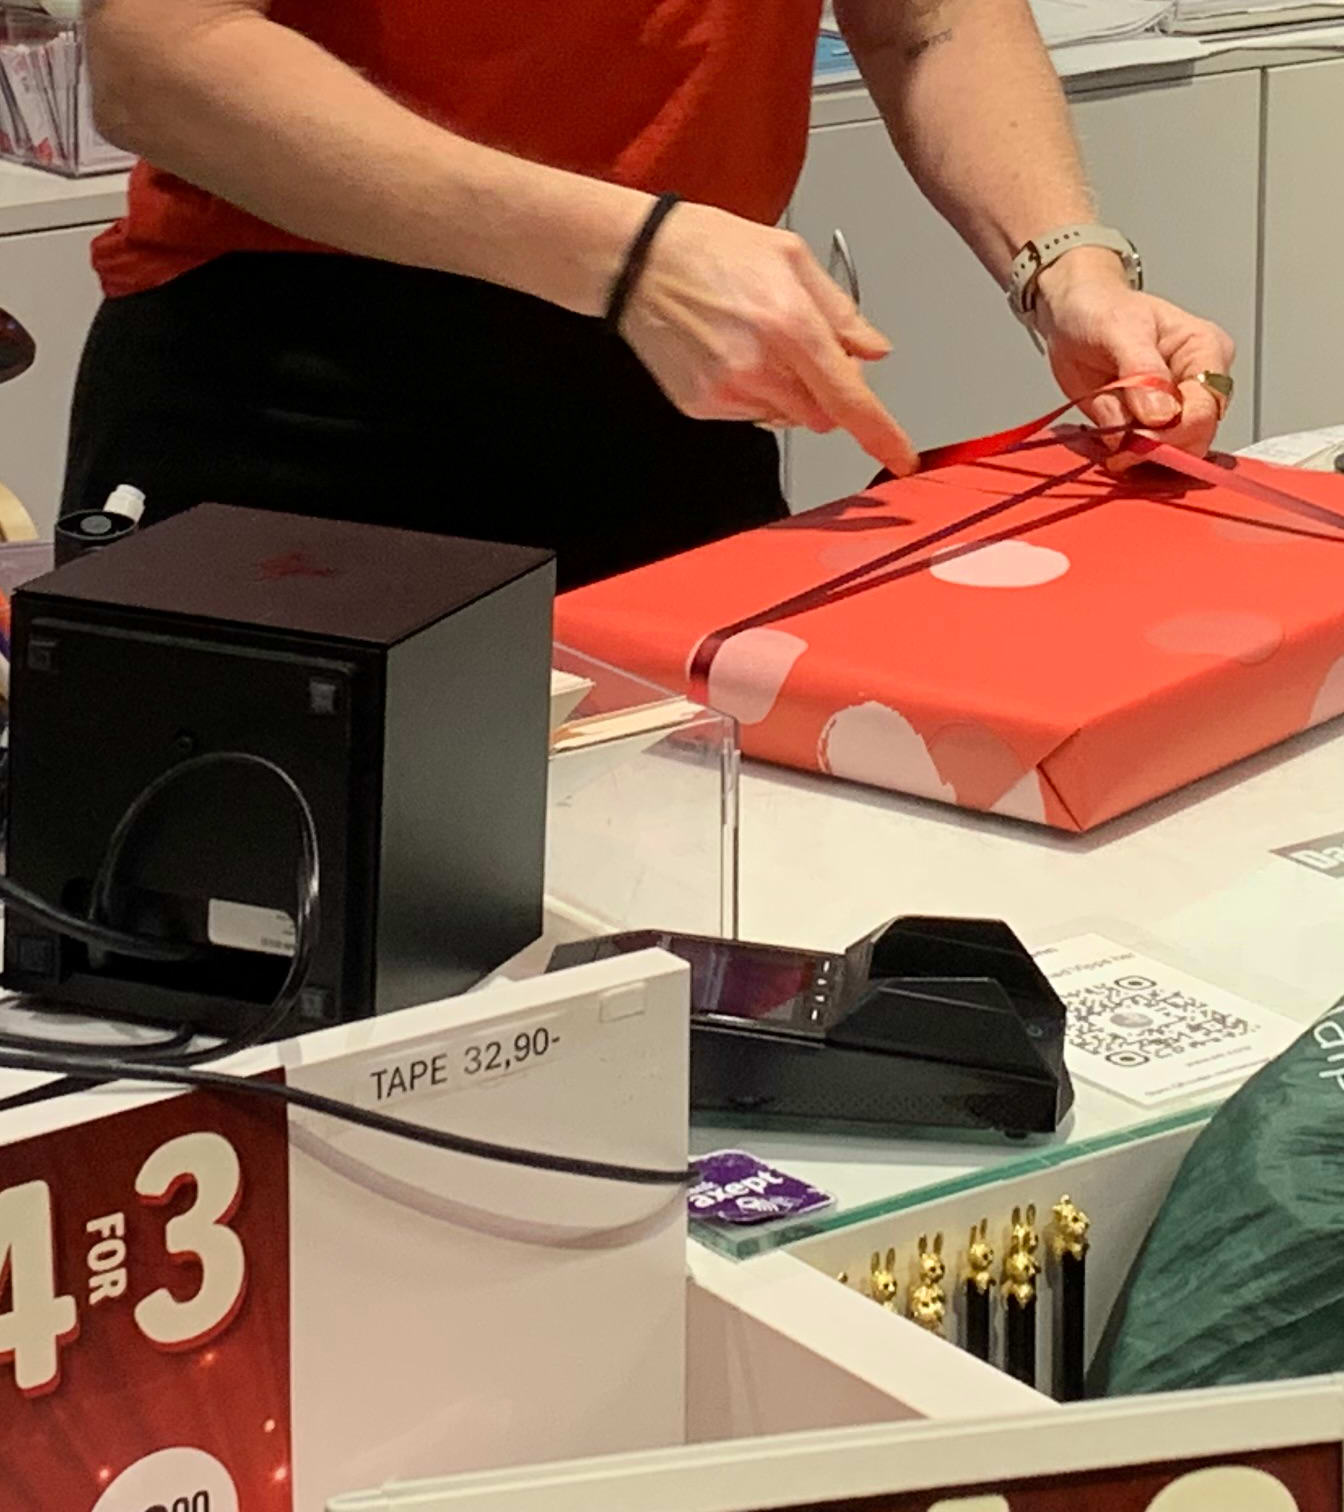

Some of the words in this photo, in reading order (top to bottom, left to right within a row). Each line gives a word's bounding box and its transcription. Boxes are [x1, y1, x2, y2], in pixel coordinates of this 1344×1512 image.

[370, 1053, 450, 1101] TAPE
[463, 1027, 561, 1076] 32,90-
[689, 1170, 784, 1208] axept
[86, 1212, 128, 1306] FOR
[134, 1131, 246, 1346] 3
